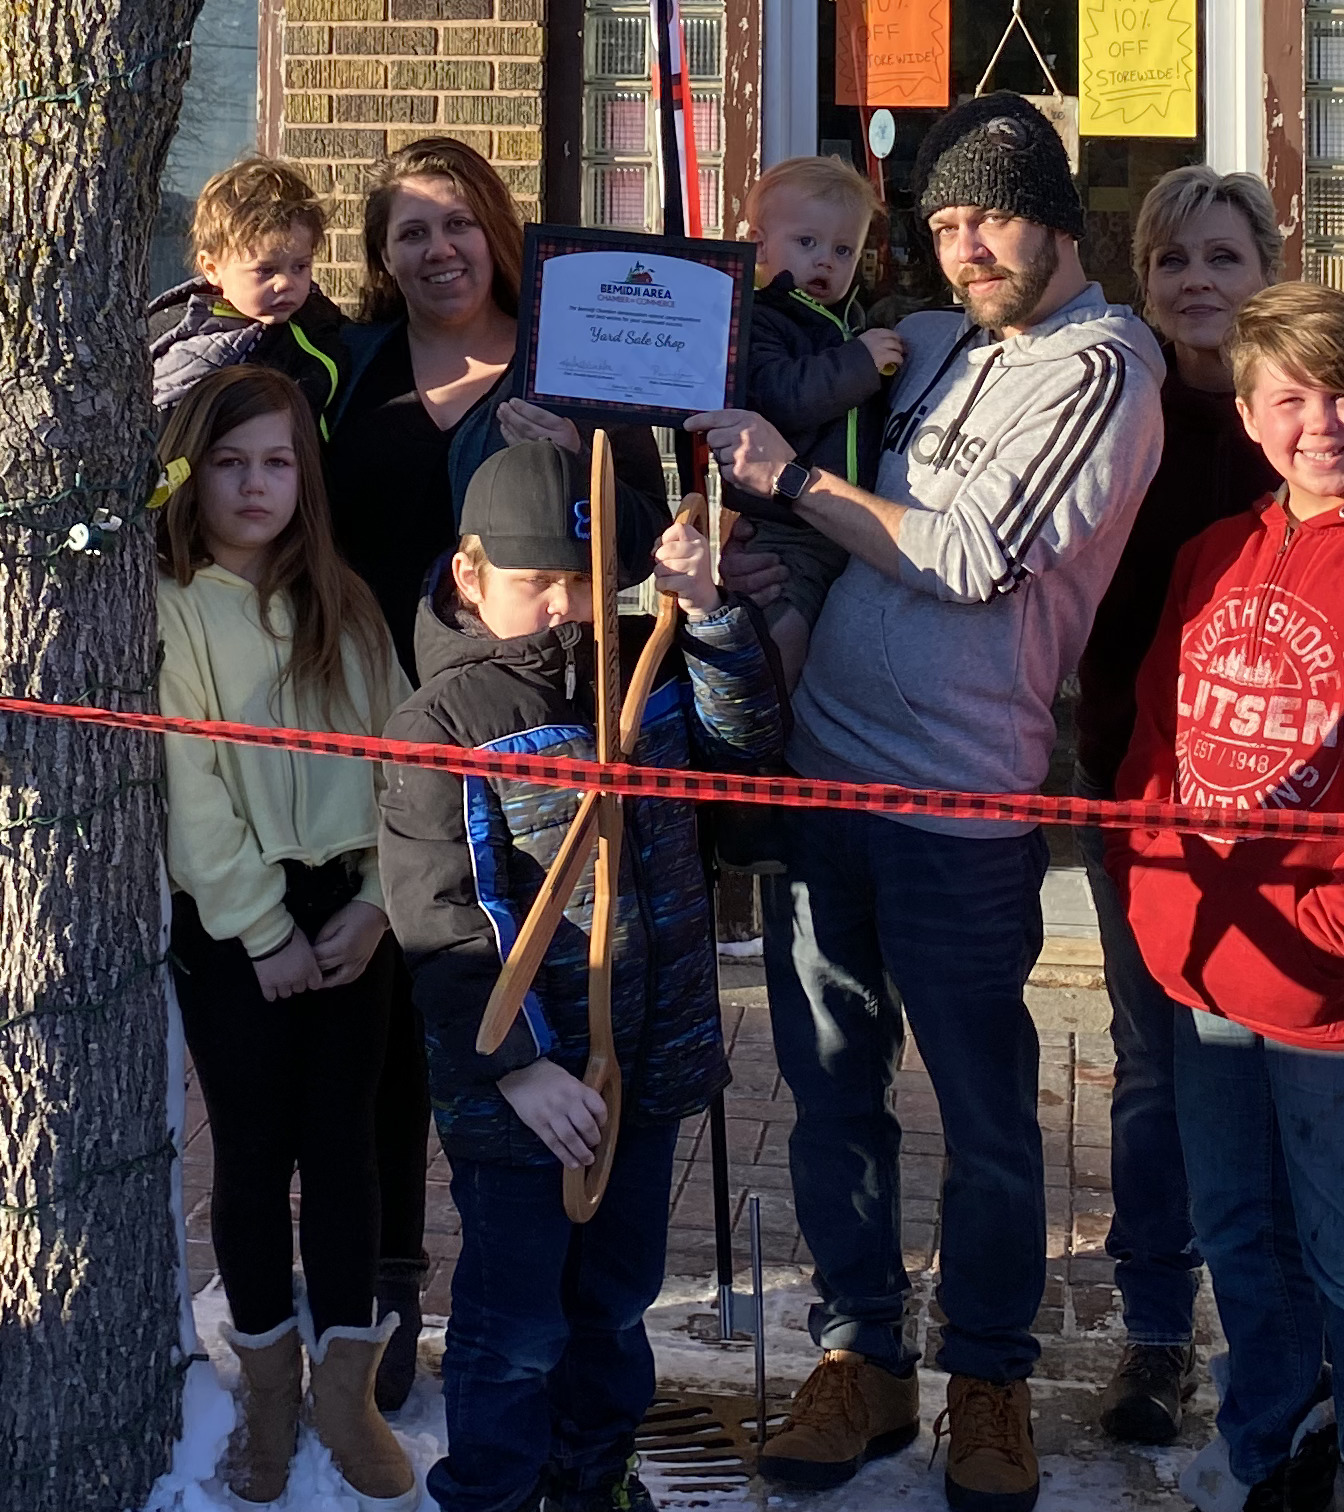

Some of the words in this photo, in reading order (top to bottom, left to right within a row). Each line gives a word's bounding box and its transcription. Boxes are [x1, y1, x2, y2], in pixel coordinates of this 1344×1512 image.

[857, 23, 901, 42] OFF
[1114, 7, 1151, 33] 10%
[1108, 39, 1149, 58] OFF
[1096, 59, 1181, 87] STOREWIDE!
[600, 283, 641, 297] BEMIDJI
[642, 287, 672, 300] AREA
[590, 326, 624, 343] Yard
[625, 330, 652, 345] Sale
[654, 333, 685, 352] Shop
[1184, 596, 1258, 672] NORTH
[1264, 601, 1342, 696] SHORE
[1193, 738, 1216, 762] EST
[1229, 749, 1270, 774] 1948
